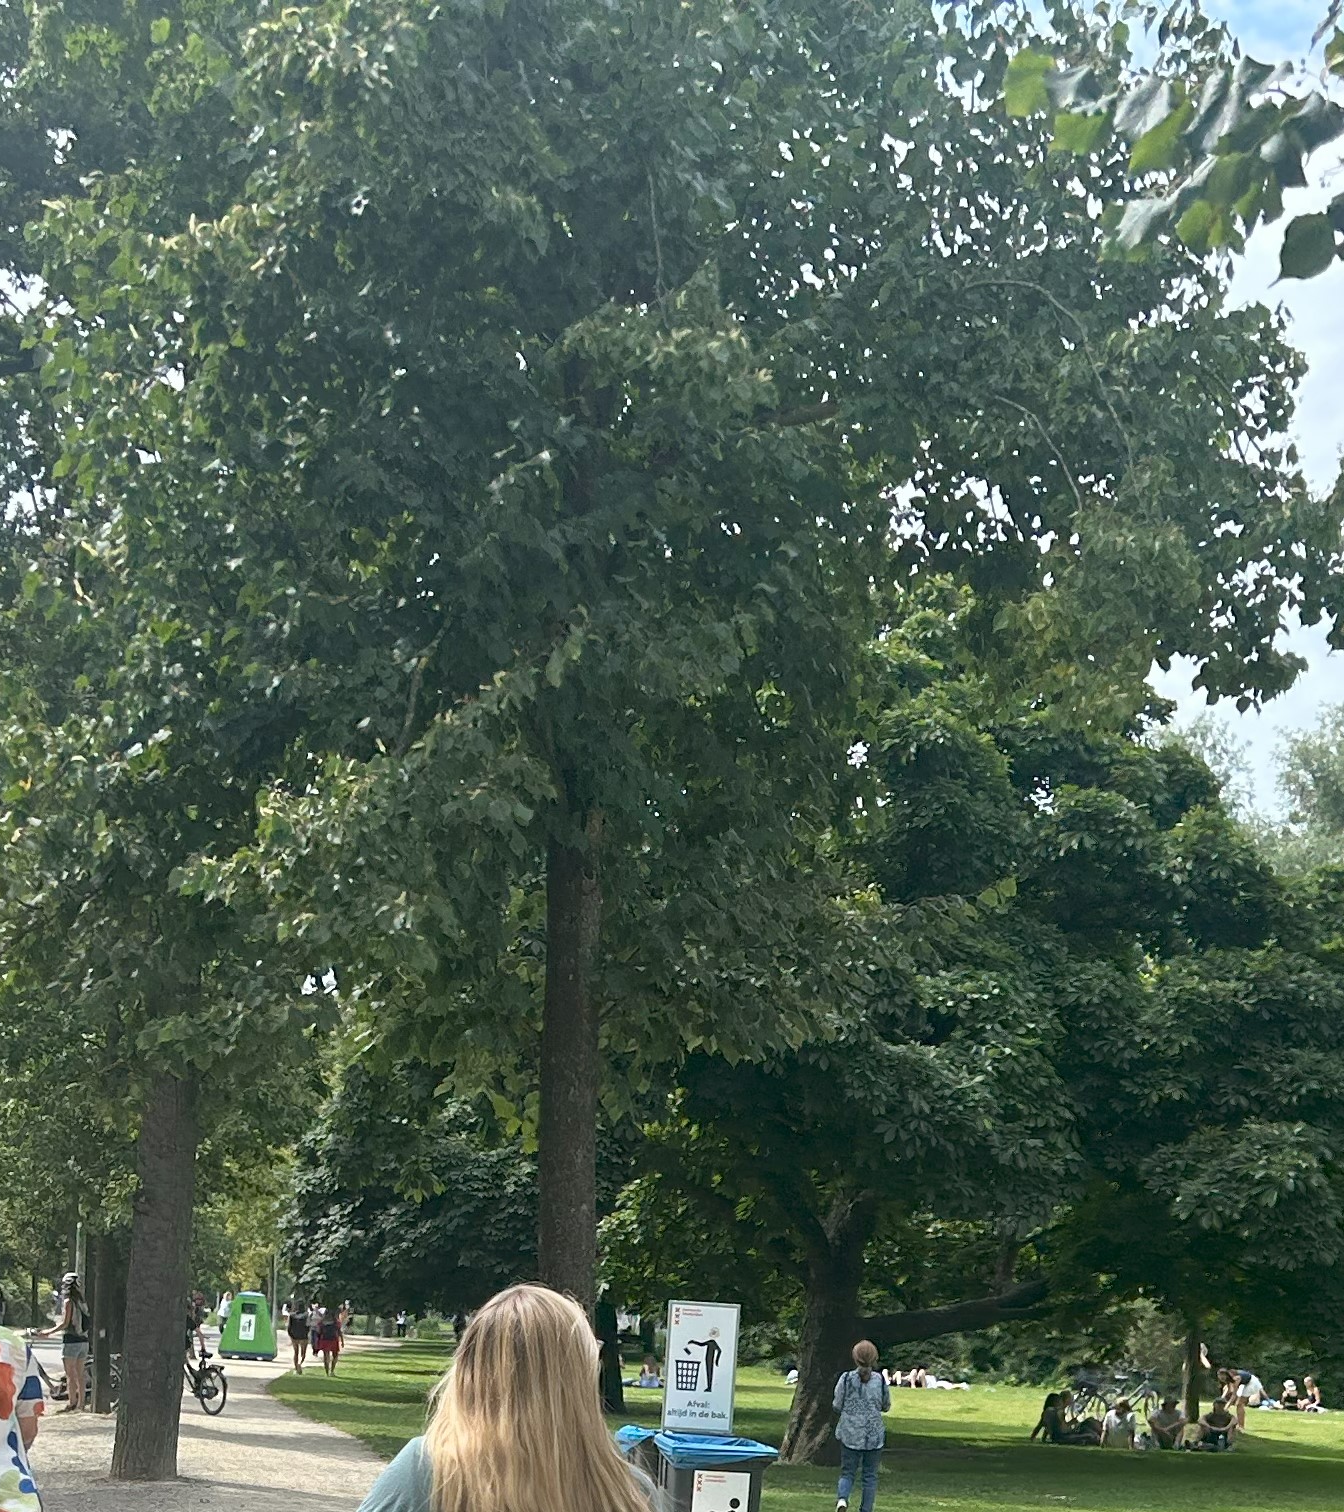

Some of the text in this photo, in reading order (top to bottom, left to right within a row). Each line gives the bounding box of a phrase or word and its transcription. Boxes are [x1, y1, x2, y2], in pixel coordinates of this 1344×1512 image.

[687, 1400, 710, 1409] Afval:
[667, 1408, 728, 1419] altijd in de bak.
